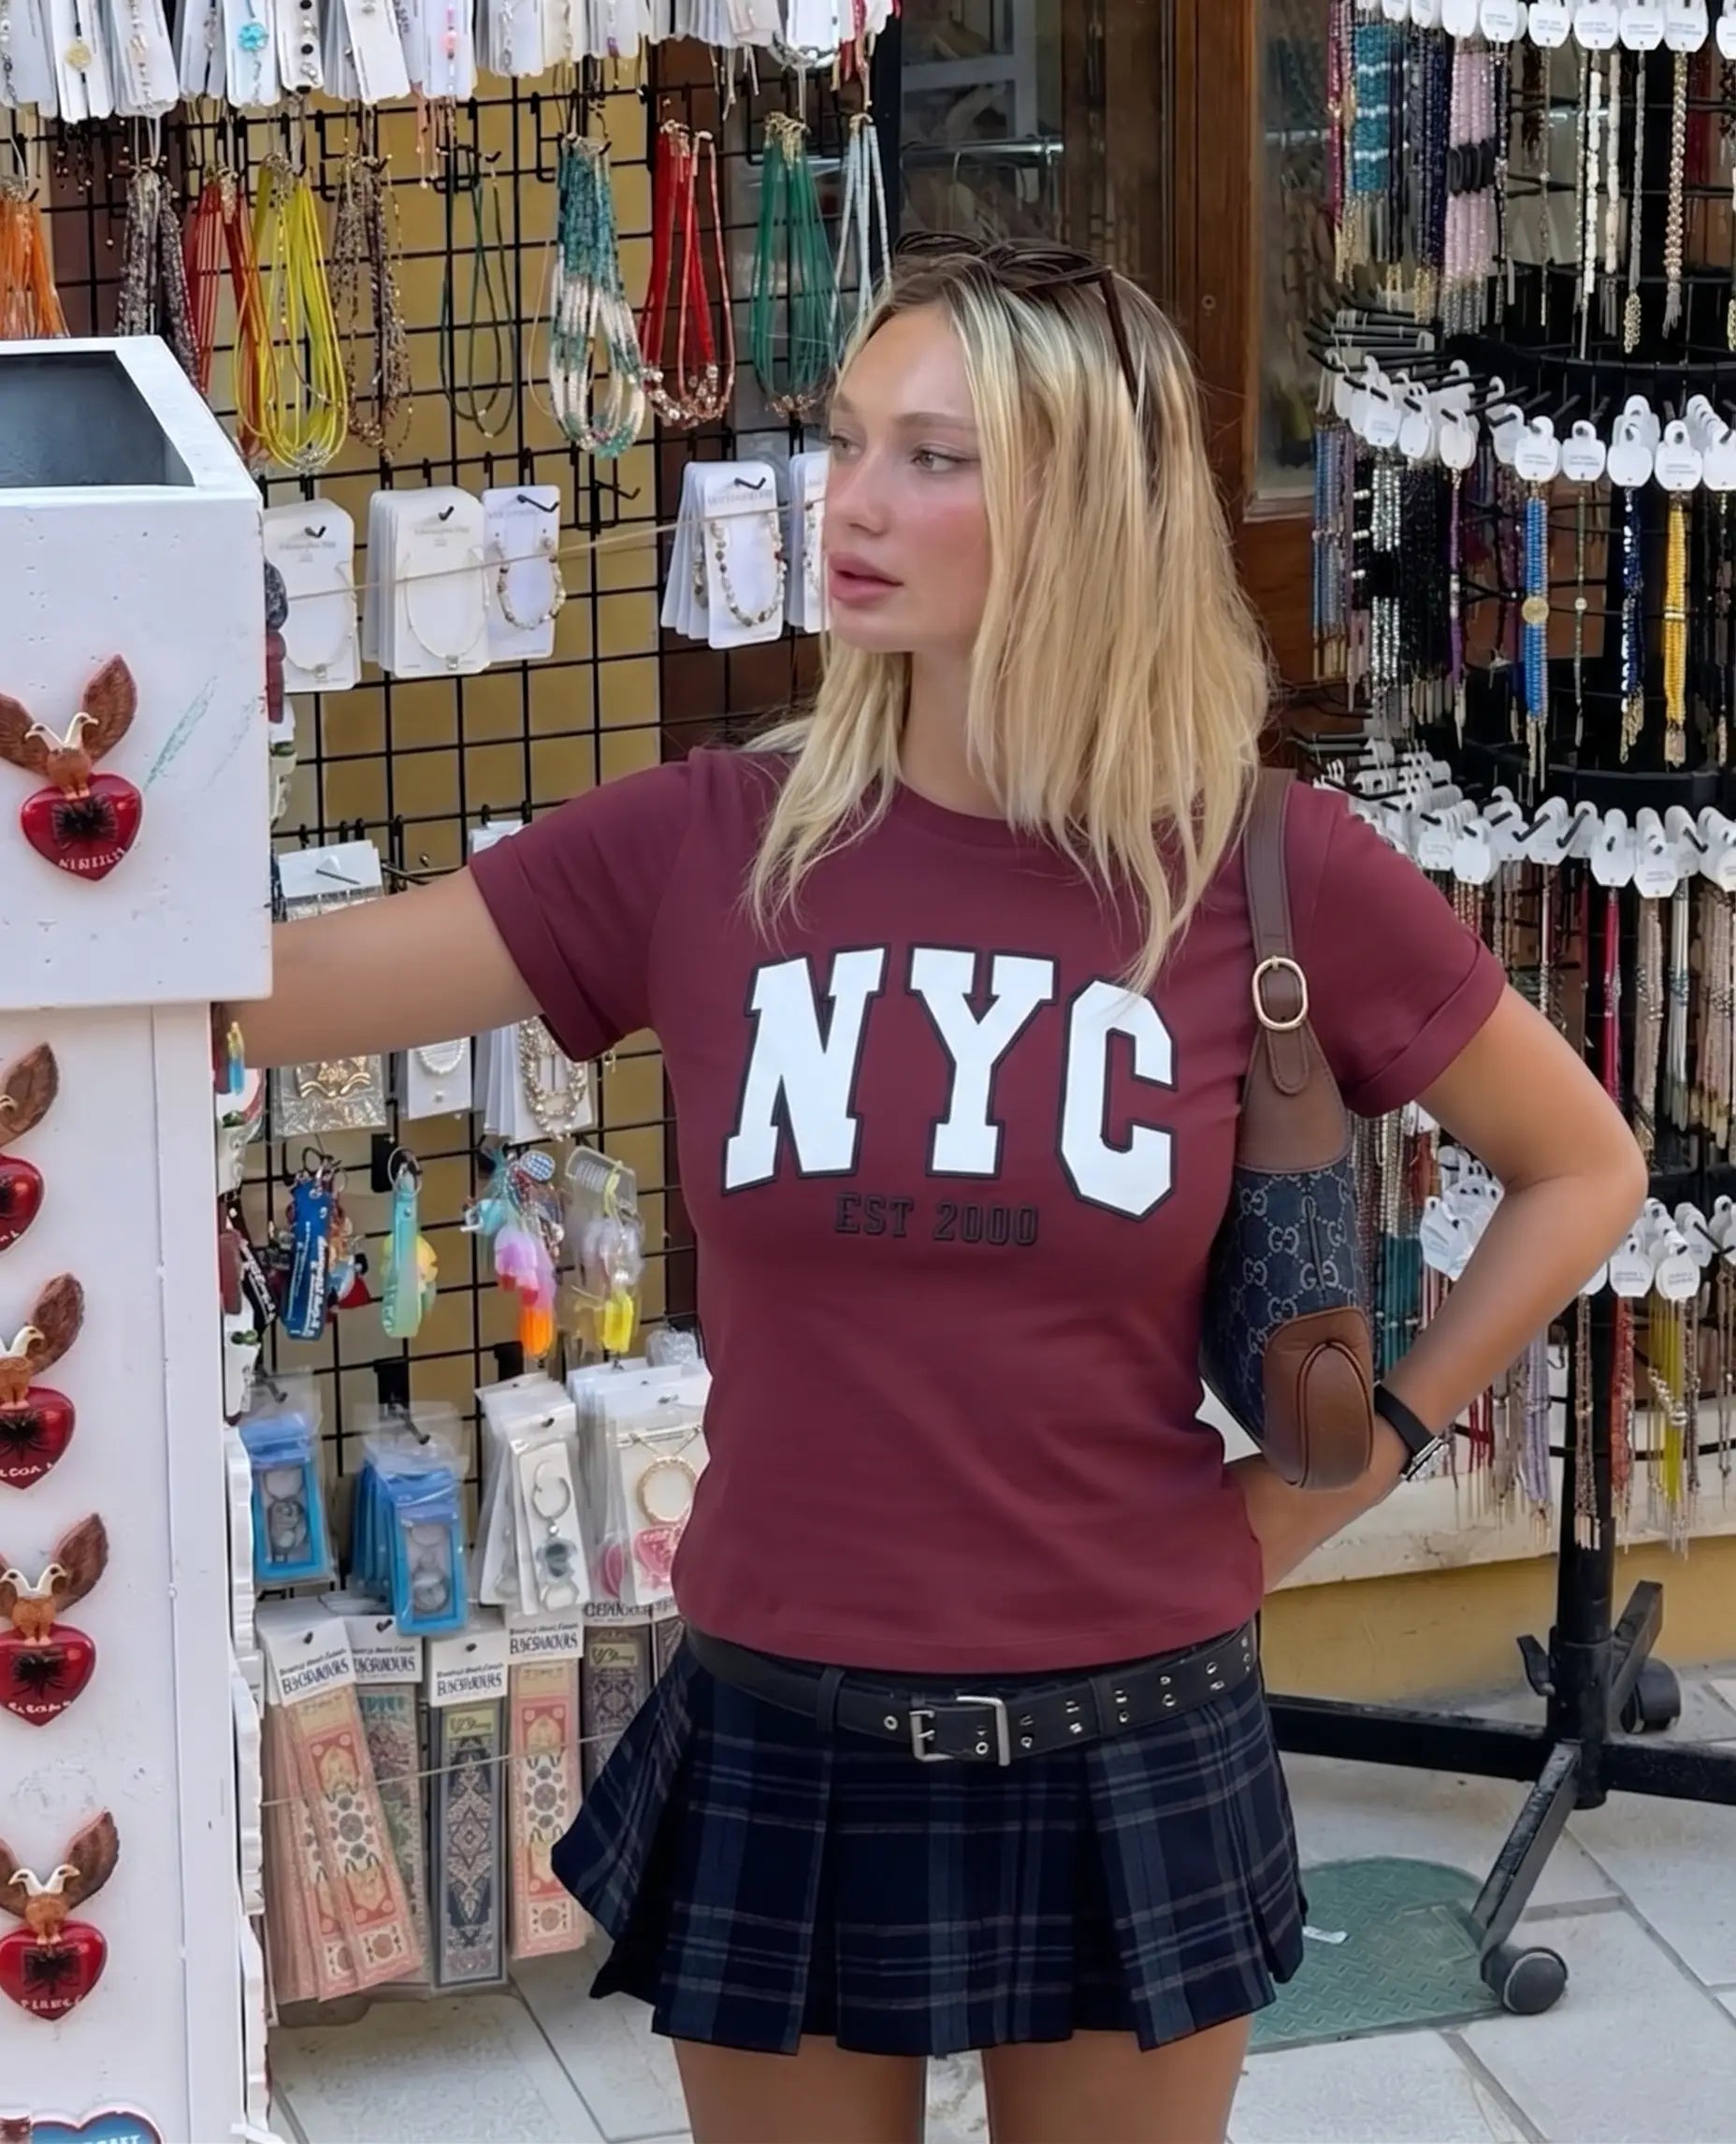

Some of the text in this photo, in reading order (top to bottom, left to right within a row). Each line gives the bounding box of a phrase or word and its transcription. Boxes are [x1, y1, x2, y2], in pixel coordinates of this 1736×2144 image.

[720, 942, 1179, 1223] NYC
[835, 1192, 1039, 1247] EST 2000
